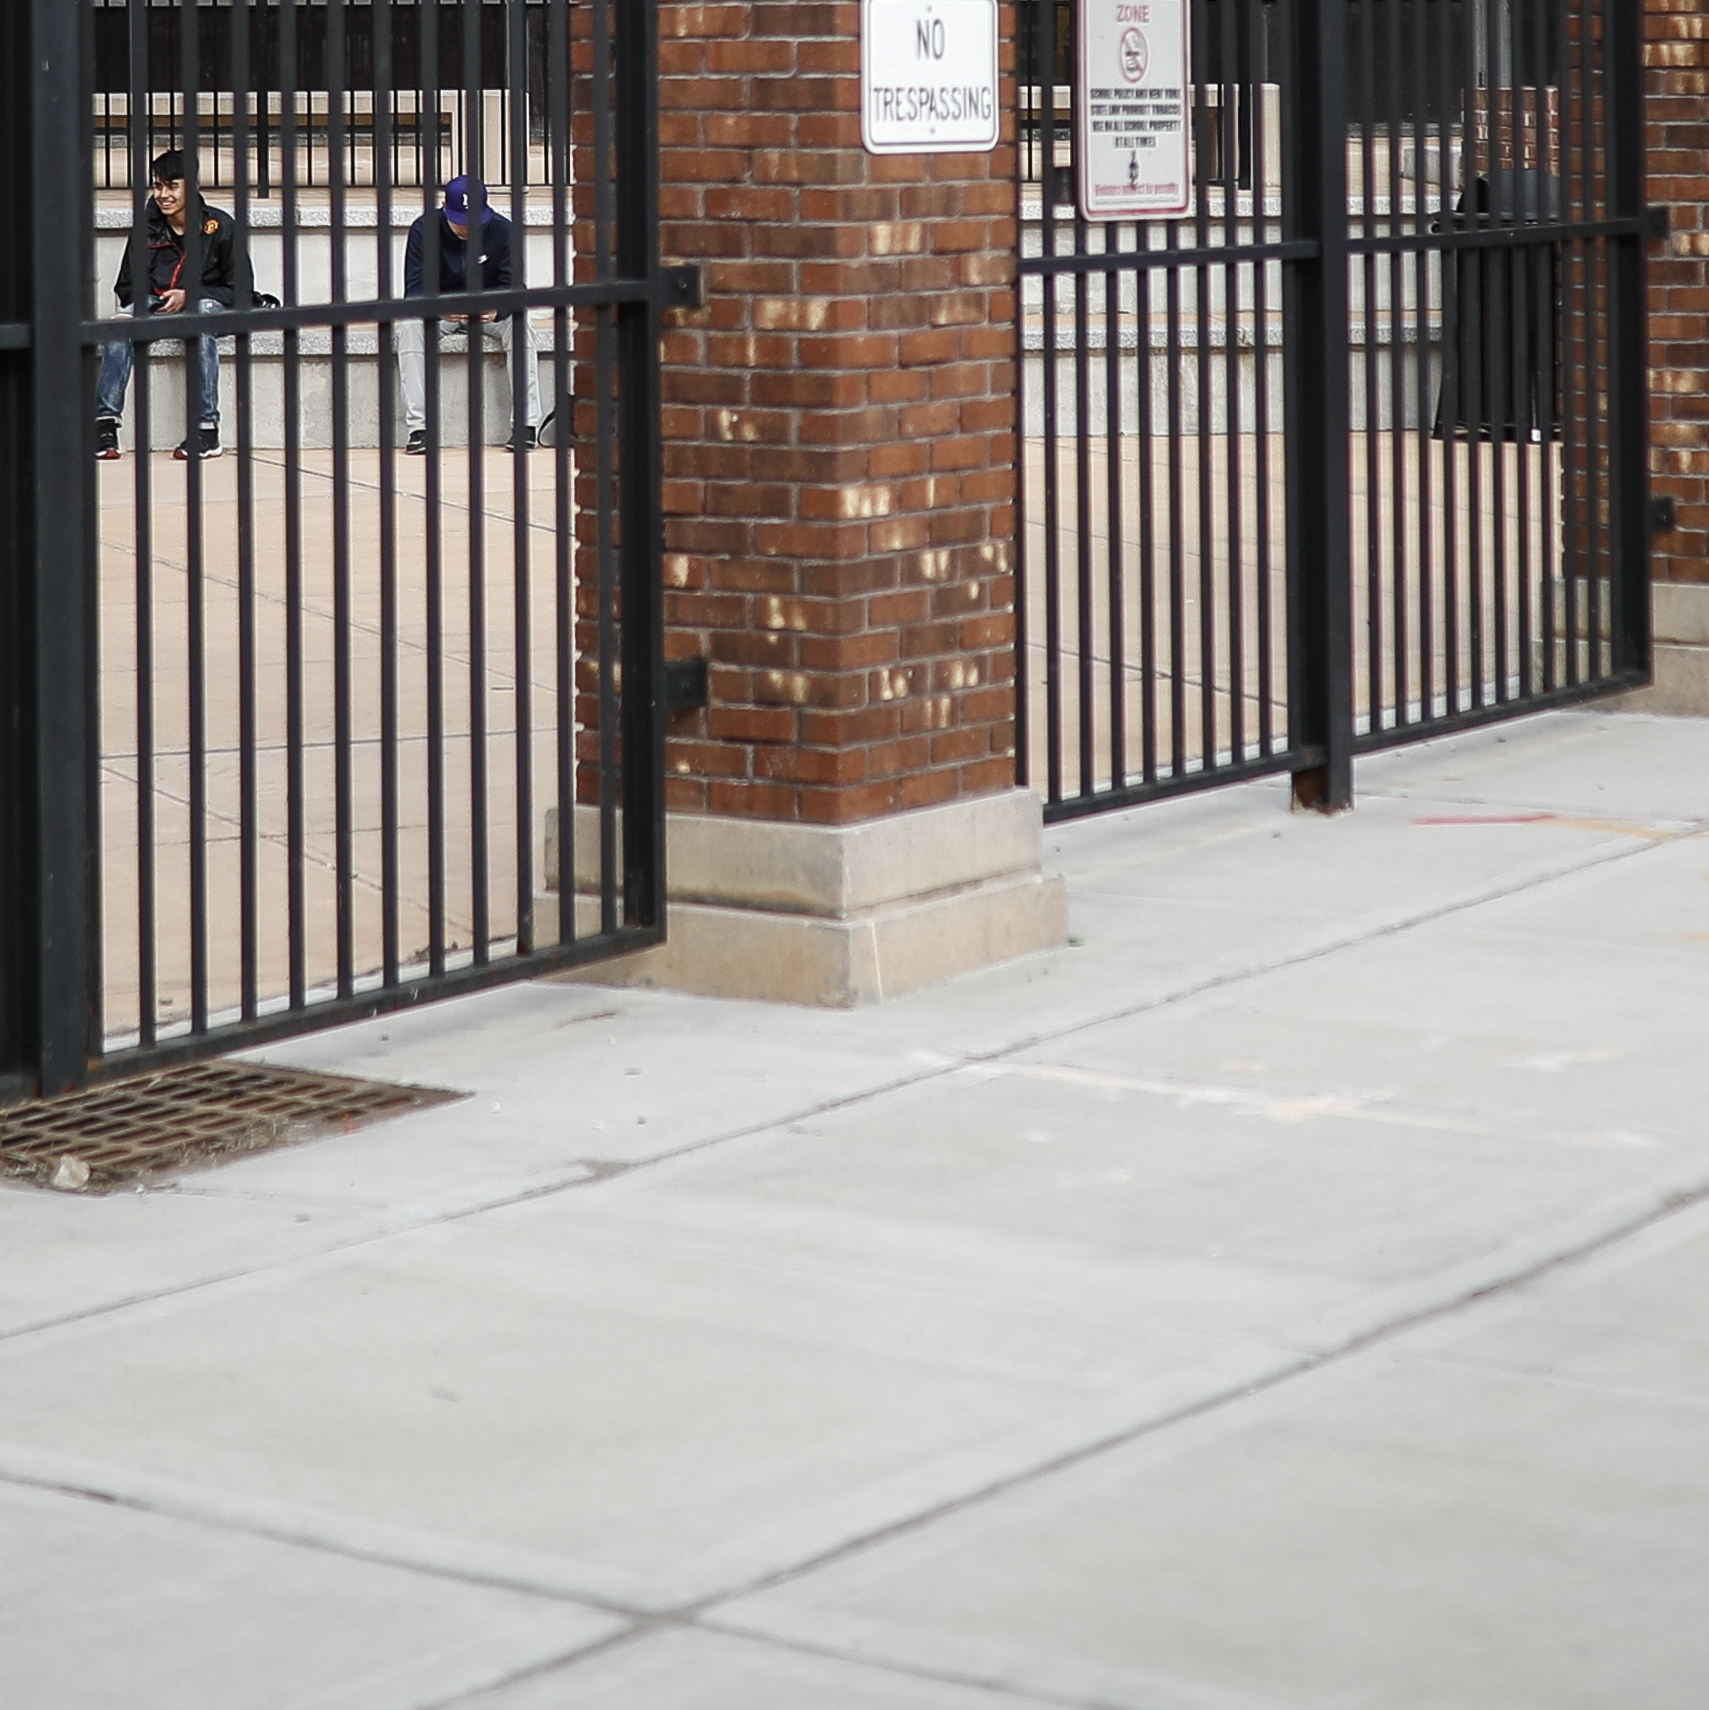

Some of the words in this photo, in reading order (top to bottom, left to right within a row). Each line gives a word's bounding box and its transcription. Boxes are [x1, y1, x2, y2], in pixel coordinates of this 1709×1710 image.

[1116, 4, 1150, 23] ZONE
[915, 18, 946, 61] NO
[872, 86, 993, 123] TRESPASSING
